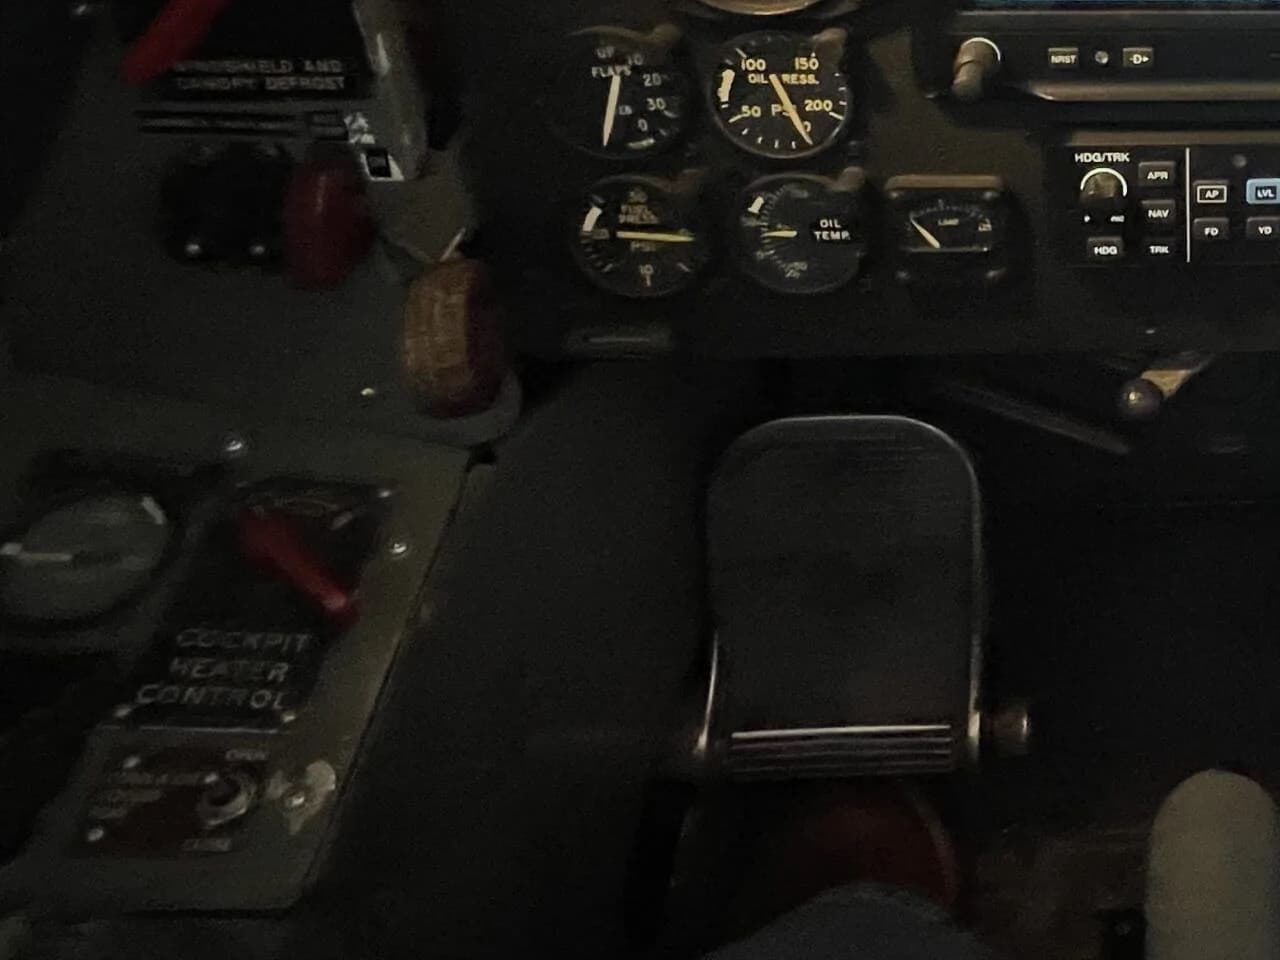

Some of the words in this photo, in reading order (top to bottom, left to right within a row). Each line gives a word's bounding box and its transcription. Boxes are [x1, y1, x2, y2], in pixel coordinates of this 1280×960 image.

[741, 59, 766, 71] 100
[794, 58, 818, 70] 150
[748, 75, 768, 84] OIL
[805, 100, 832, 111] 200
[742, 106, 761, 117] 50
[1075, 153, 1130, 163] HDG/TRK
[1147, 171, 1168, 180] APR
[1205, 190, 1218, 198] AP
[1257, 189, 1274, 197] LVL
[1148, 209, 1169, 217] NAV
[820, 219, 841, 228] OIL
[1259, 226, 1272, 235] YD
[1094, 246, 1117, 255] HDG
[1150, 245, 1169, 253] TRK
[136, 683, 287, 710] CONTROL
